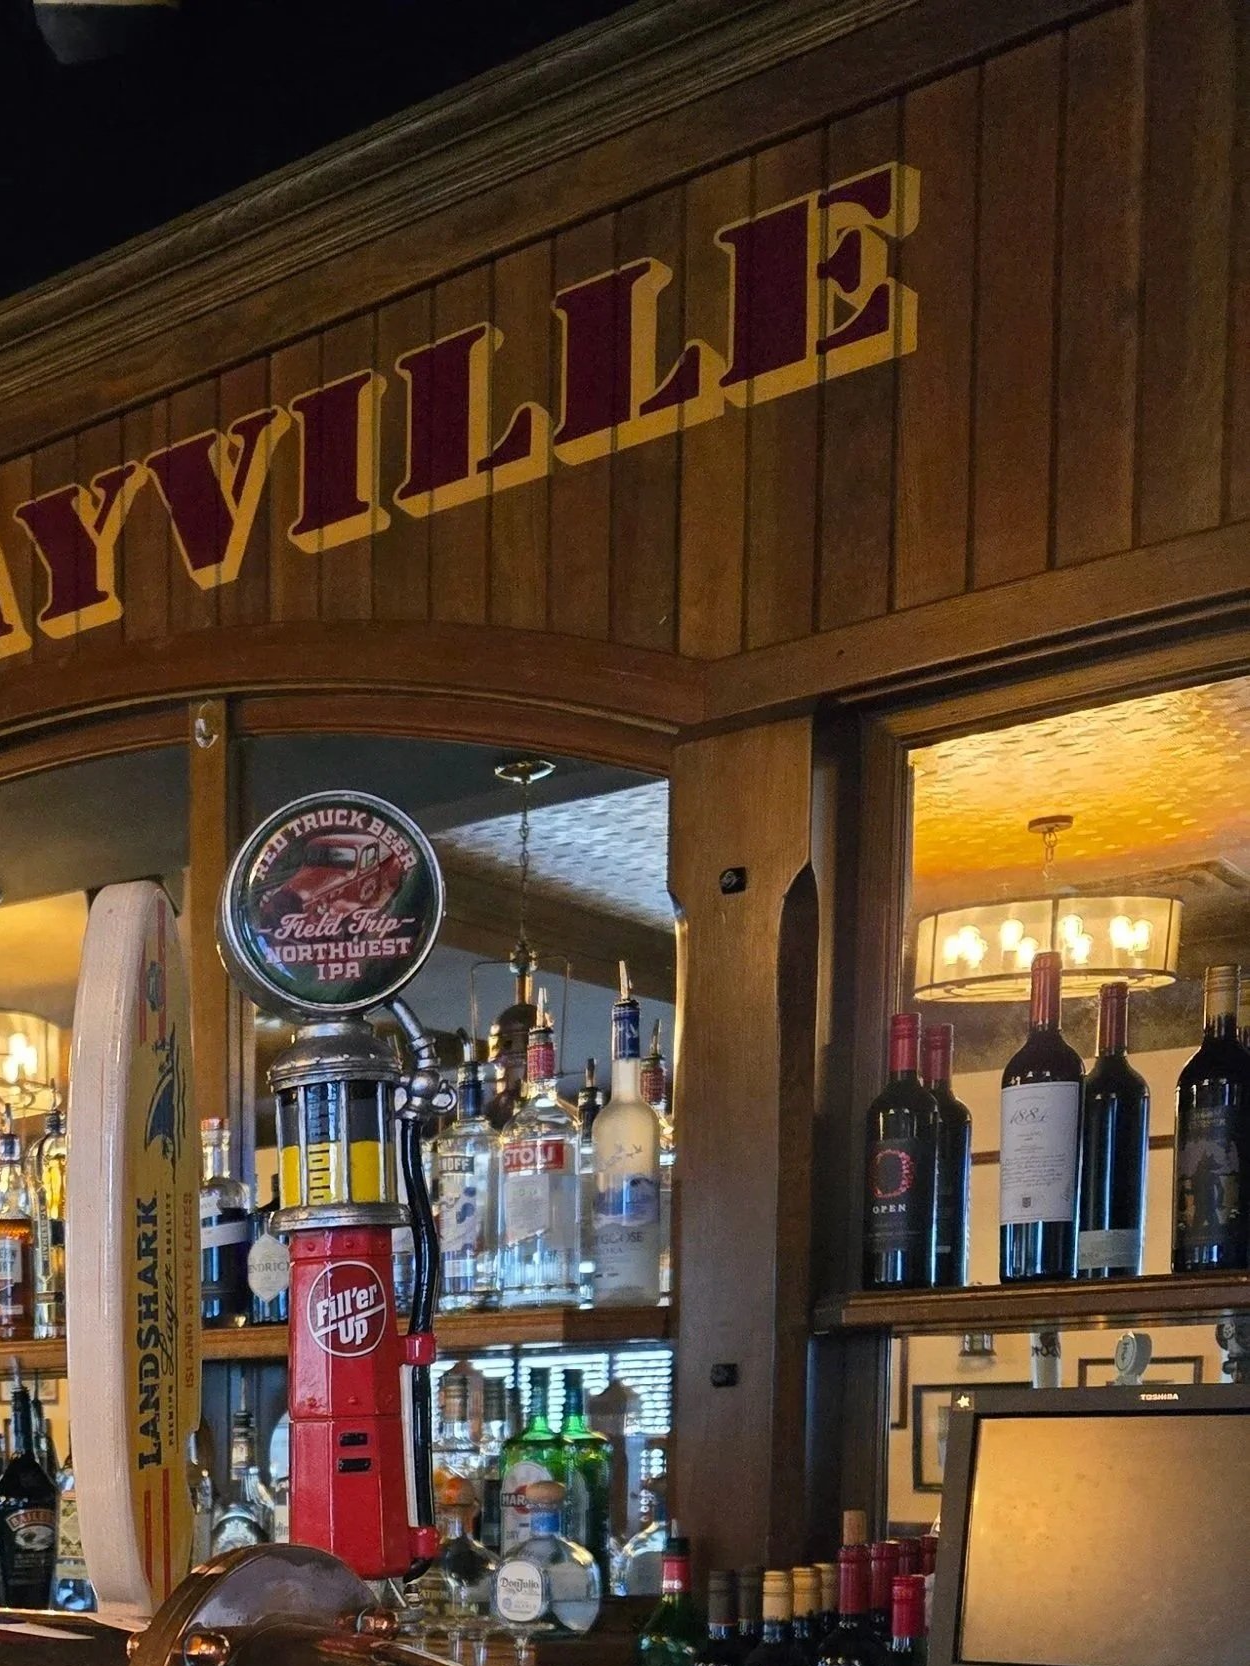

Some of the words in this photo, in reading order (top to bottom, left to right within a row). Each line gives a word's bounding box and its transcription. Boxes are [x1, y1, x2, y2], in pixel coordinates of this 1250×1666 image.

[255, 836, 288, 880] RED
[289, 809, 367, 838] TRUCK
[367, 817, 418, 871] BEER
[274, 913, 343, 940] Field
[348, 908, 402, 938] Trip
[266, 937, 411, 963] NORTHWEST
[317, 962, 360, 980] IPA
[872, 1203, 907, 1214] OPEN
[316, 1284, 377, 1328] Fill'er
[137, 1197, 162, 1470] LANDSHARK
[338, 1316, 368, 1345] Up
[1141, 1393, 1179, 1401] TOSHIBA
